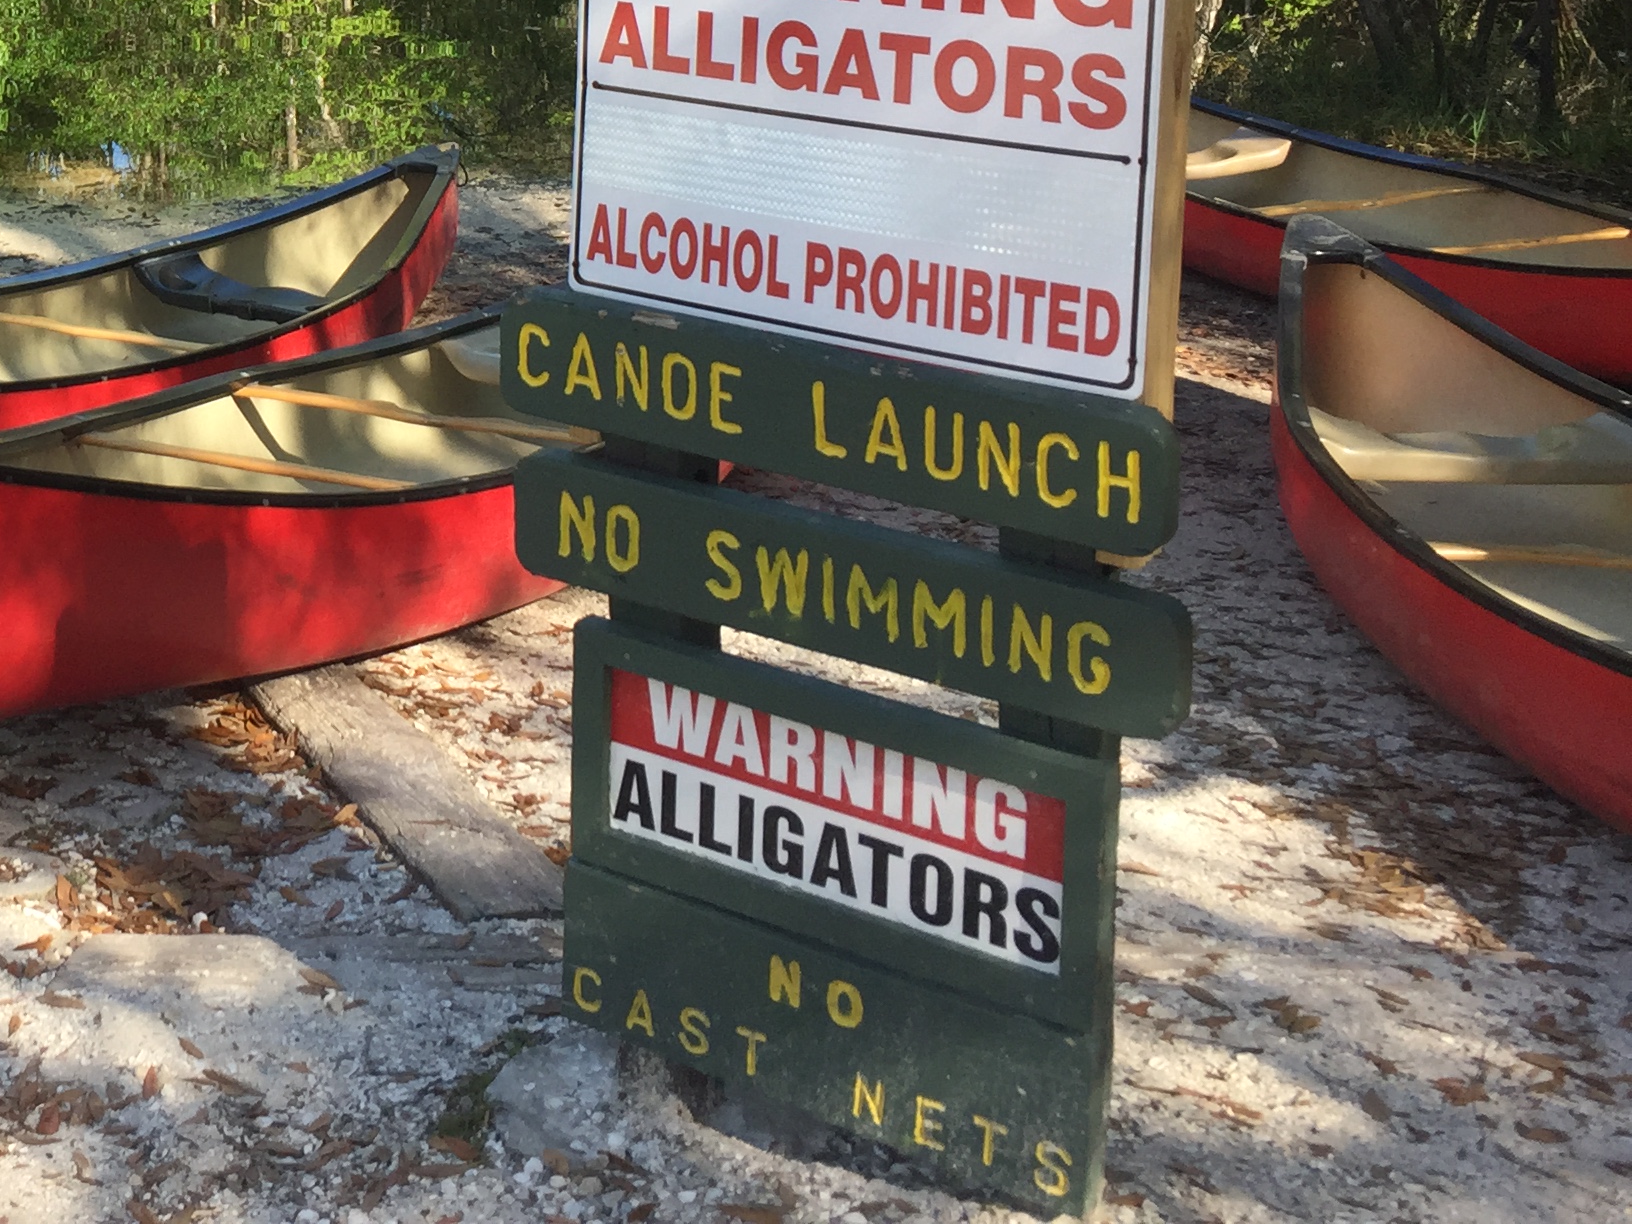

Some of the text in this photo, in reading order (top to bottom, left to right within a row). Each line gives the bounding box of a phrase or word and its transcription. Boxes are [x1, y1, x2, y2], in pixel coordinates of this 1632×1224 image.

[599, 1, 1127, 130] ALLIGATORS
[587, 203, 1120, 356] ALCOHOL PROHIBITED
[517, 323, 1141, 523] CANOE LAUNCH
[559, 492, 1111, 695] NO SWIMMING
[613, 758, 1060, 964] ALLIGATORS
[648, 678, 1027, 859] WARNING
[572, 968, 1072, 1197] CAST NETS
[769, 955, 863, 1027] NO
